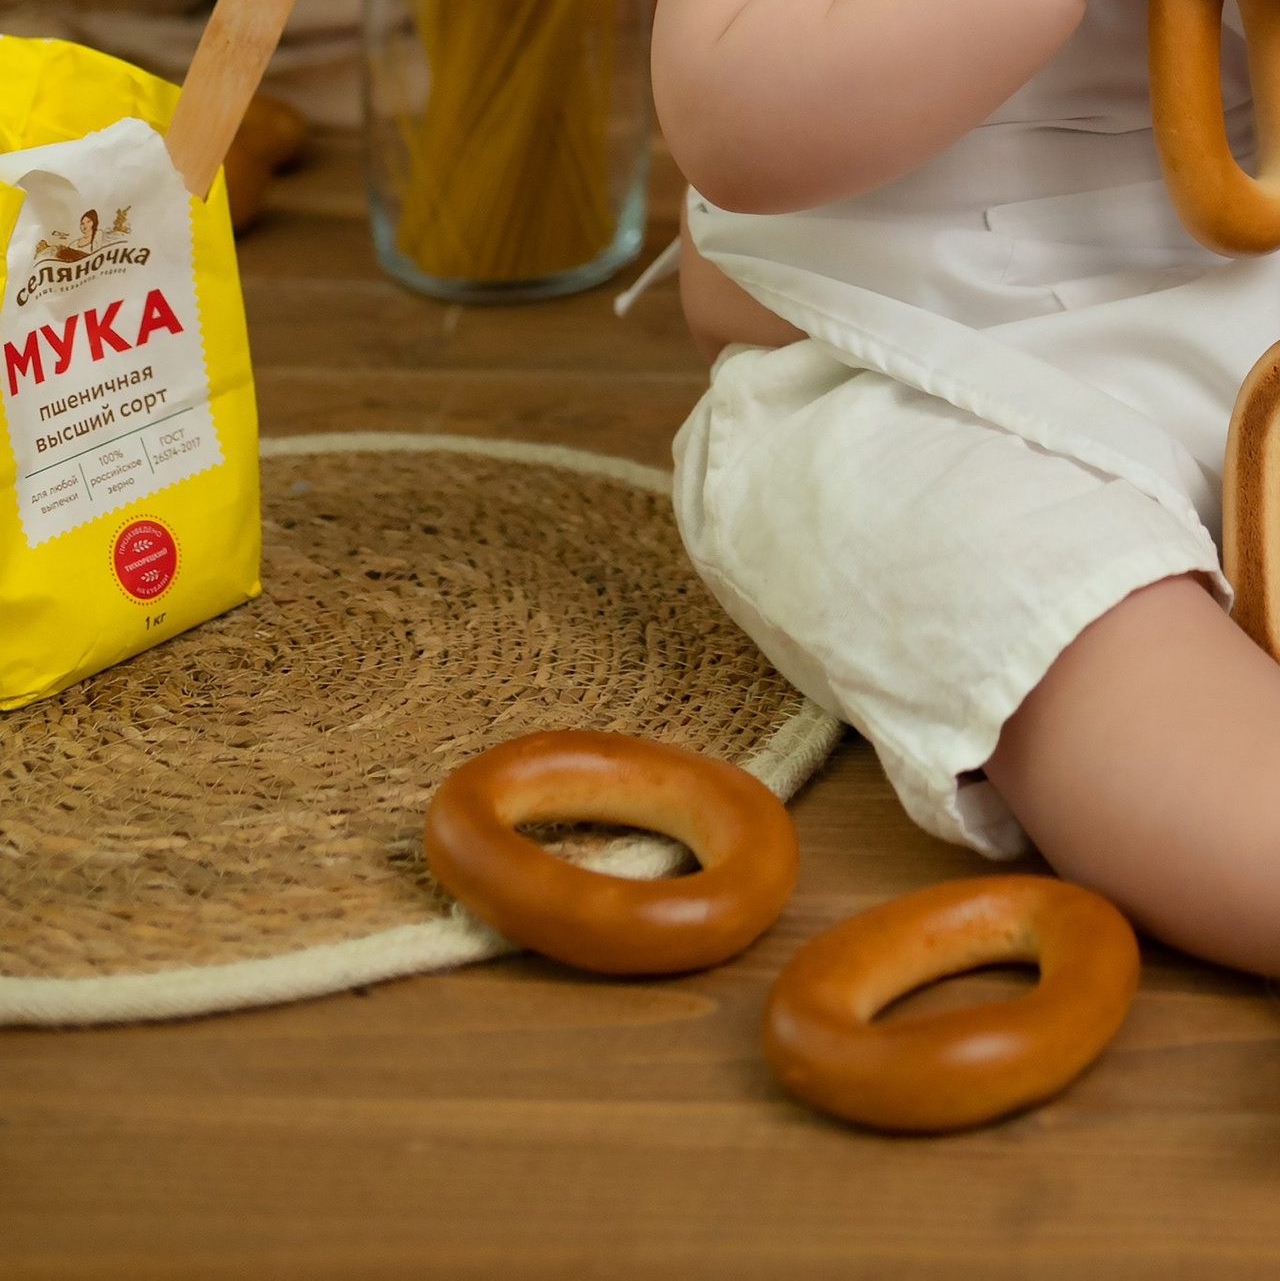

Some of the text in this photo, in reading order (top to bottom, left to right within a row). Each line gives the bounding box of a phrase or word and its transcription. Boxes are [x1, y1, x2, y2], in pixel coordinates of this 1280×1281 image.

[3, 288, 185, 397] МУКА
[39, 365, 154, 422] пшеничная
[35, 388, 168, 454] высший сорт
[158, 427, 186, 447] ГОСТ
[98, 448, 125, 467] 100%
[89, 458, 143, 488] российское
[31, 475, 79, 504] для любой
[107, 477, 135, 495] зерно
[40, 492, 80, 514] выпечки
[145, 612, 167, 631] 1 кг
